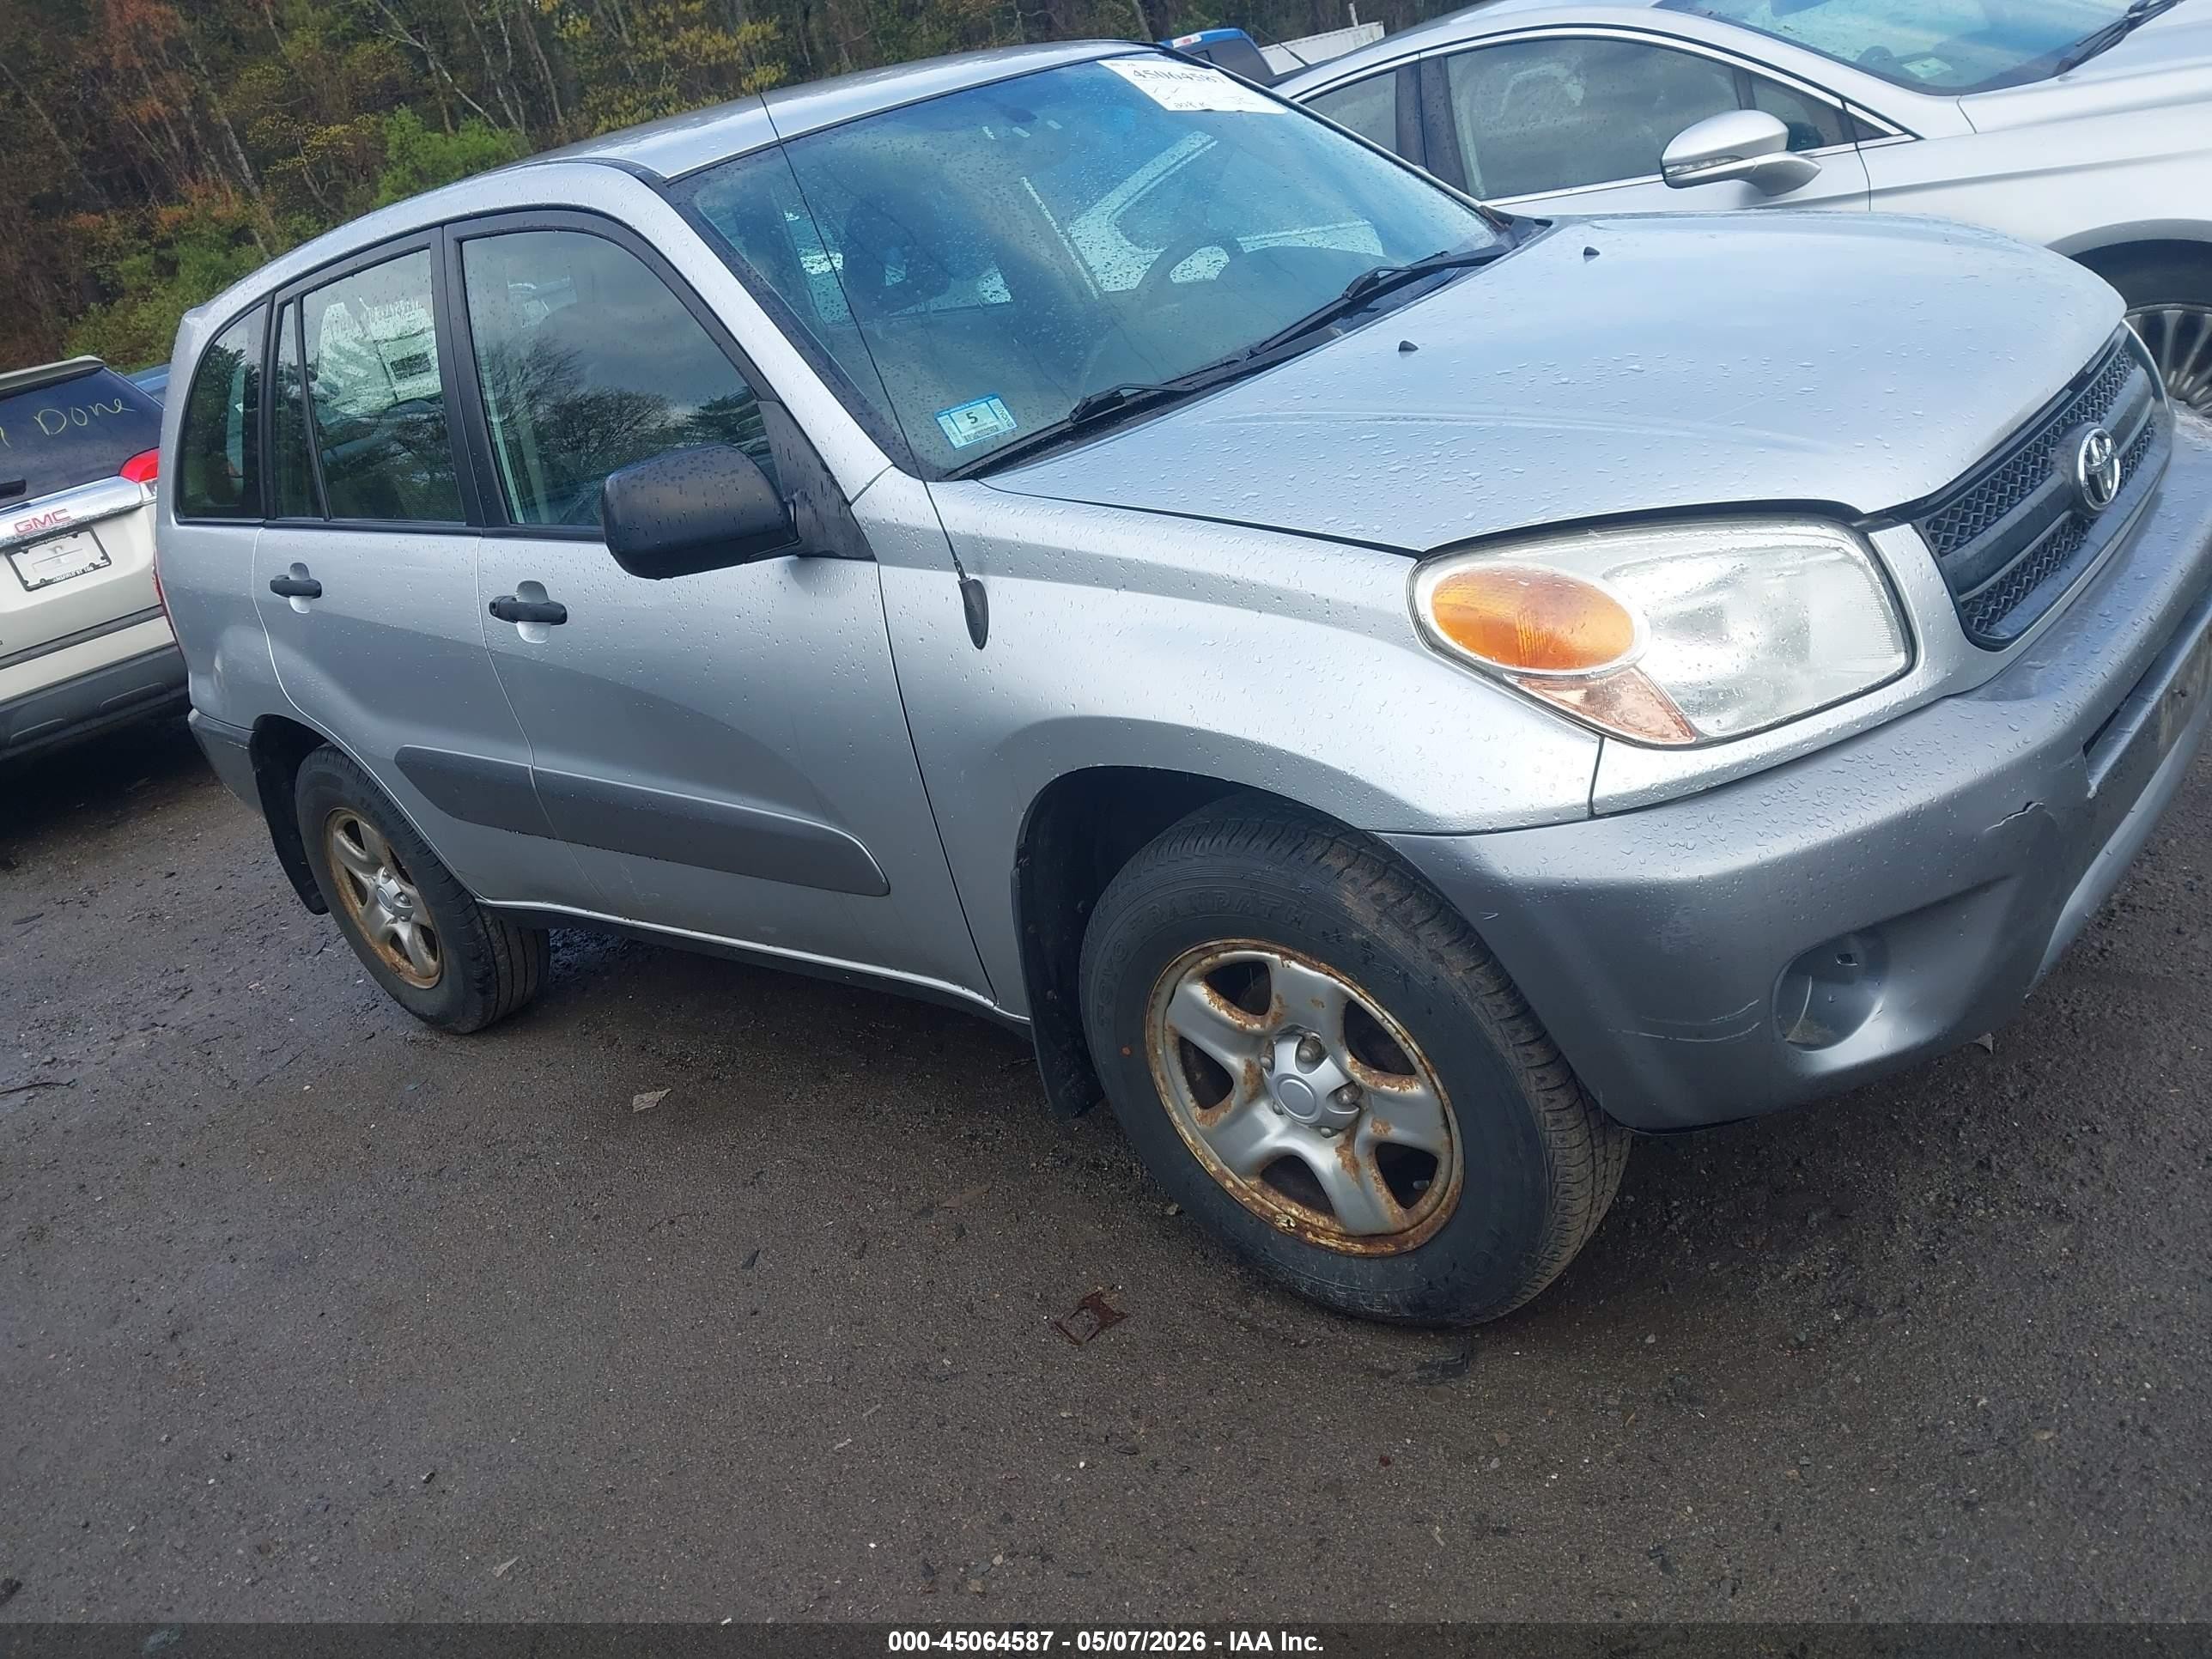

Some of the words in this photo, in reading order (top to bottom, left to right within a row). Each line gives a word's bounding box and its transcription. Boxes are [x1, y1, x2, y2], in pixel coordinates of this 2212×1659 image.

[33, 398, 136, 435] Done
[965, 410, 979, 424] 5
[15, 508, 72, 533] GMC
